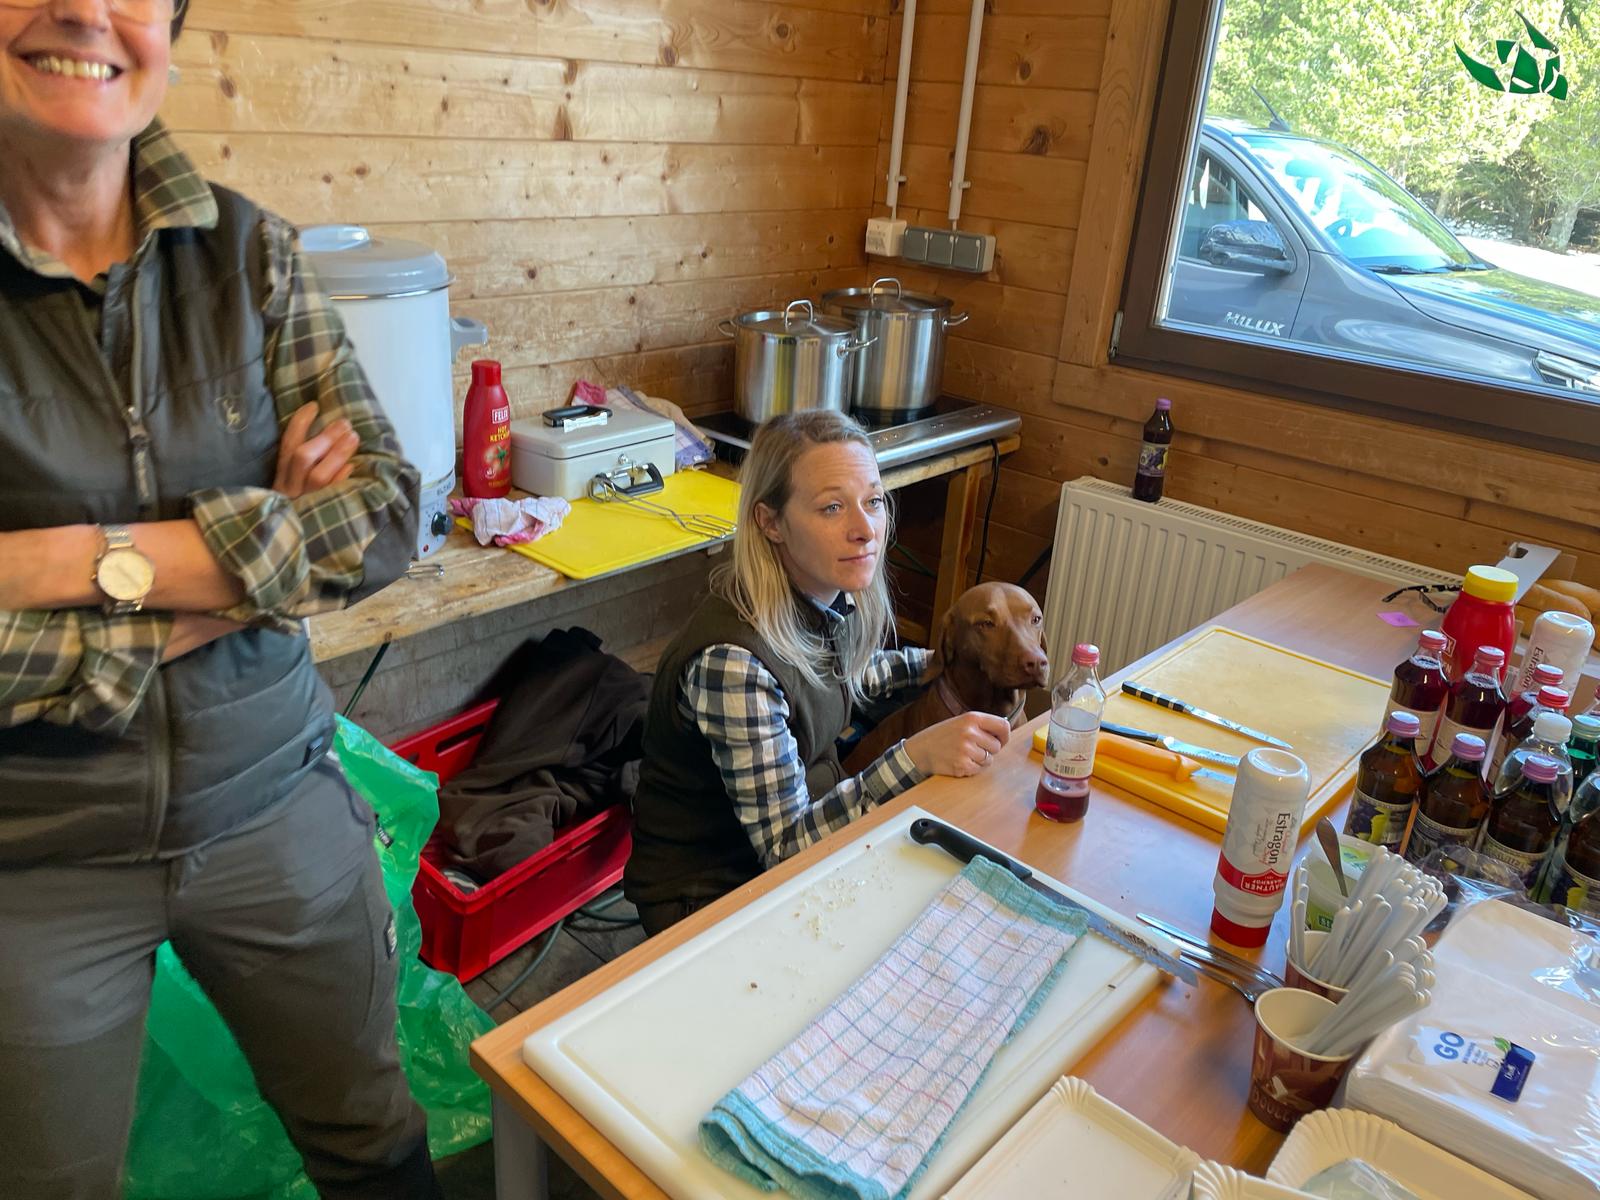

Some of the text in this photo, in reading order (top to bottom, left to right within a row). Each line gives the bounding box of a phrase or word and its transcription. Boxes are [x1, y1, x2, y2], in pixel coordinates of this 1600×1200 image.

[1224, 311, 1286, 337] HILUX
[494, 409, 509, 422] FELIX
[1523, 646, 1544, 688] Estragon
[1268, 812, 1291, 865] Estragon
[1433, 1031, 1465, 1060] GO
